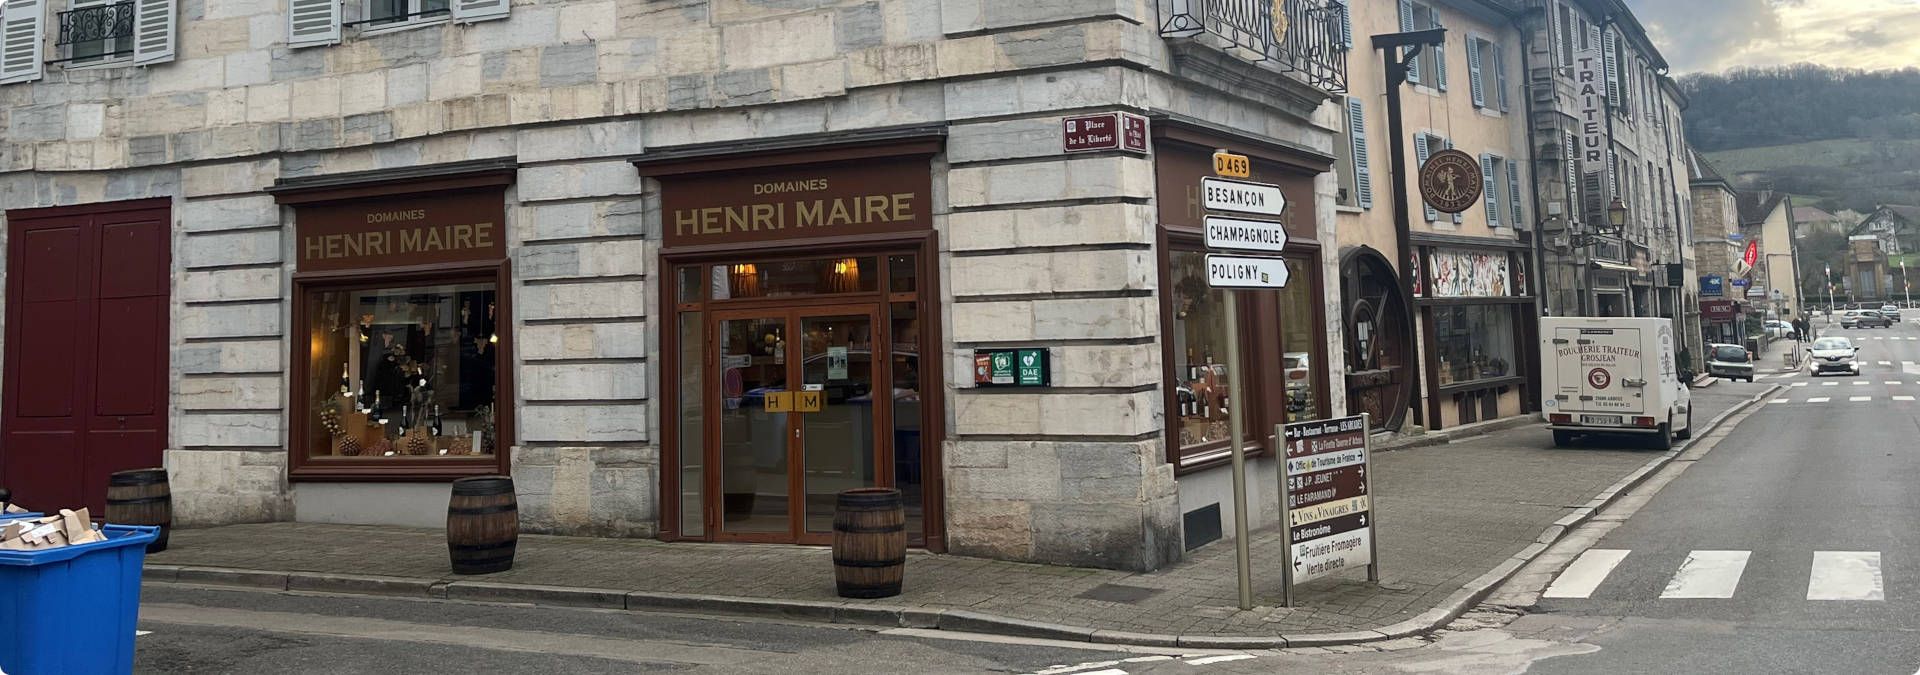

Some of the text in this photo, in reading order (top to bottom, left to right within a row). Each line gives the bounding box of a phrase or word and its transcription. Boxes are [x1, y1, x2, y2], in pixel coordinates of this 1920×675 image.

[1578, 57, 1601, 162] TRAITEUR
[1084, 120, 1105, 131] Place
[1078, 136, 1085, 144] la
[1087, 134, 1112, 145] Liberté
[1217, 157, 1247, 174] D 469
[754, 178, 828, 195] DOMAINES
[1207, 187, 1264, 207] BESANÇON
[366, 209, 425, 224] DOMAINES
[675, 192, 916, 236] HENRI MAIRE
[305, 222, 493, 259] HENRI MAIRE
[1210, 226, 1280, 244] CHAMPAGNOLE
[1211, 264, 1258, 280] POLIGNY
[1558, 345, 1640, 359] BOUCHERIE TRAITEUR
[1581, 354, 1616, 362] GROSJEAN
[768, 395, 817, 409] H M
[1317, 456, 1336, 467] Tourisme
[1314, 472, 1332, 484] JEUNET
[1297, 495, 1304, 505] LE
[1293, 525, 1331, 541] Le Bistronôme
[1305, 536, 1362, 559] Fruitière Fromagère
[1306, 557, 1345, 576] Vente directe
